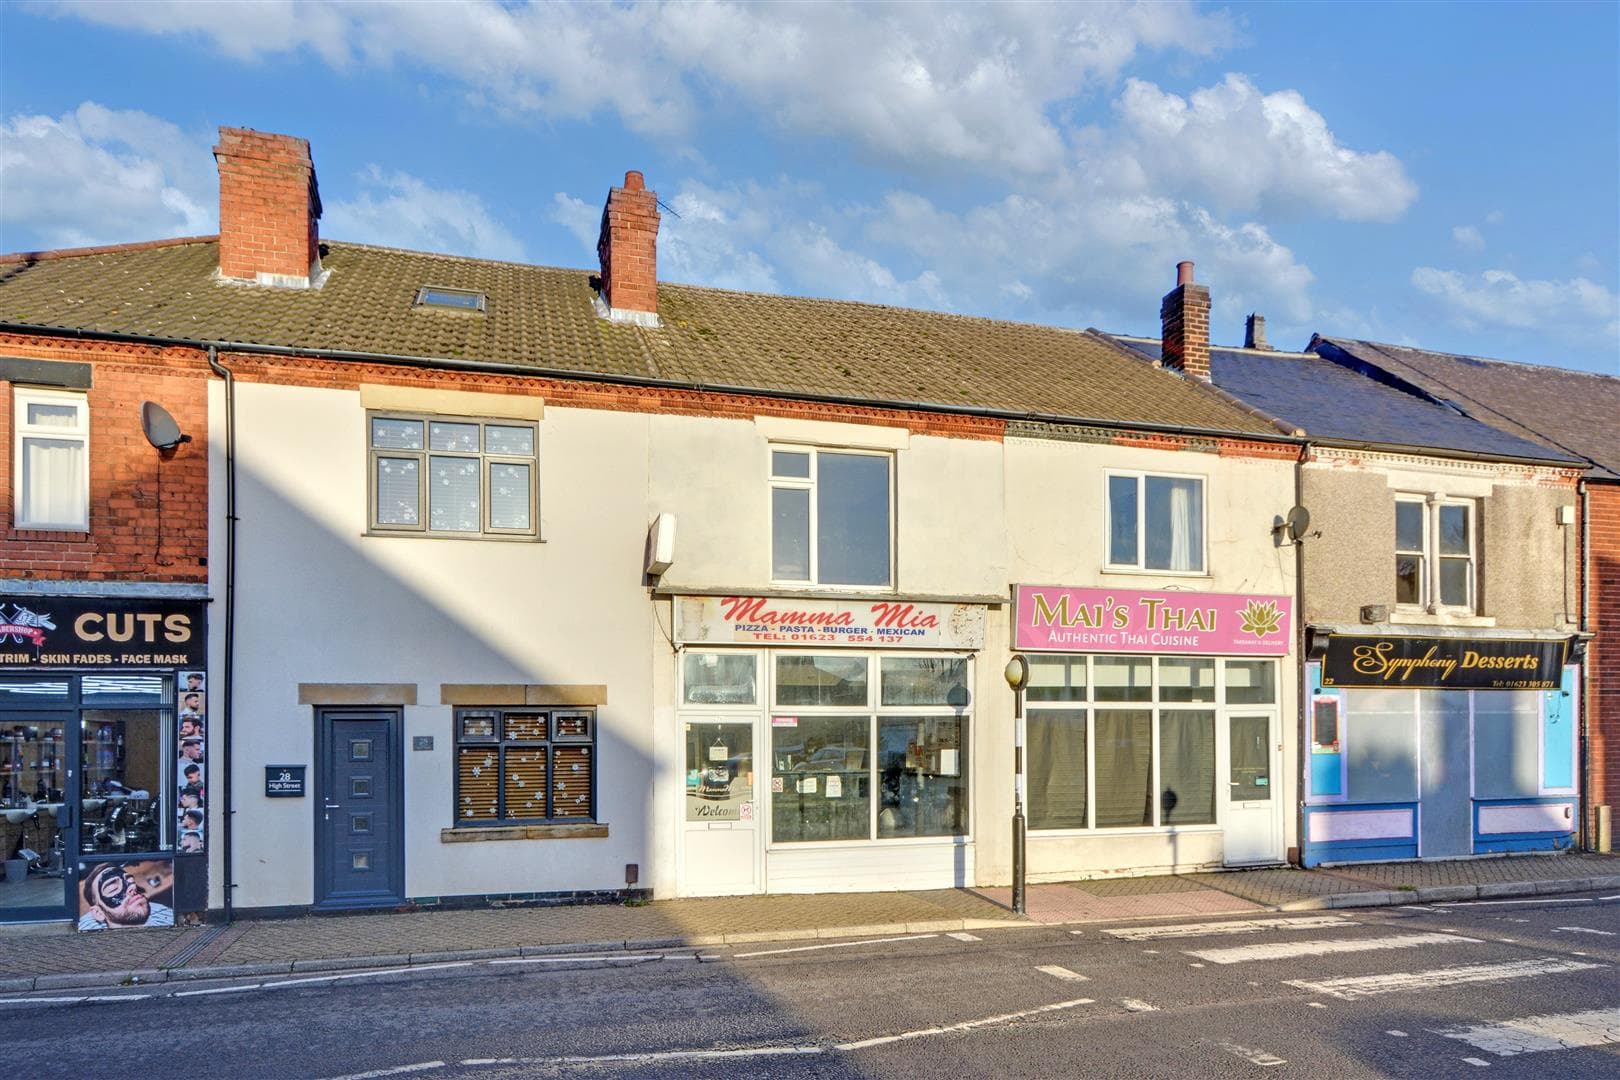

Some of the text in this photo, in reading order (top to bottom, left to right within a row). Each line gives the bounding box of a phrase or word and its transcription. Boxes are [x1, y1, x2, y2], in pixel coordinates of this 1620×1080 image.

[720, 597, 940, 629] Mamma Mia
[1139, 597, 1217, 633] THAI
[74, 612, 192, 643] CUTS
[735, 624, 768, 632] PIZZA
[779, 625, 814, 633] PASTA
[823, 626, 868, 634] BURGER
[876, 628, 926, 636] MEXICAN
[752, 632, 786, 640] TEL:
[1048, 629, 1199, 647] AUTHENTIC THAI CUISINE
[0, 653, 30, 664] TRIM
[40, 654, 70, 664] SKIN
[73, 654, 112, 664] FADES
[121, 654, 150, 664] FACE
[153, 654, 188, 664] MASK
[1353, 642, 1539, 680] Symphony Desserts
[279, 772, 291, 781] 28
